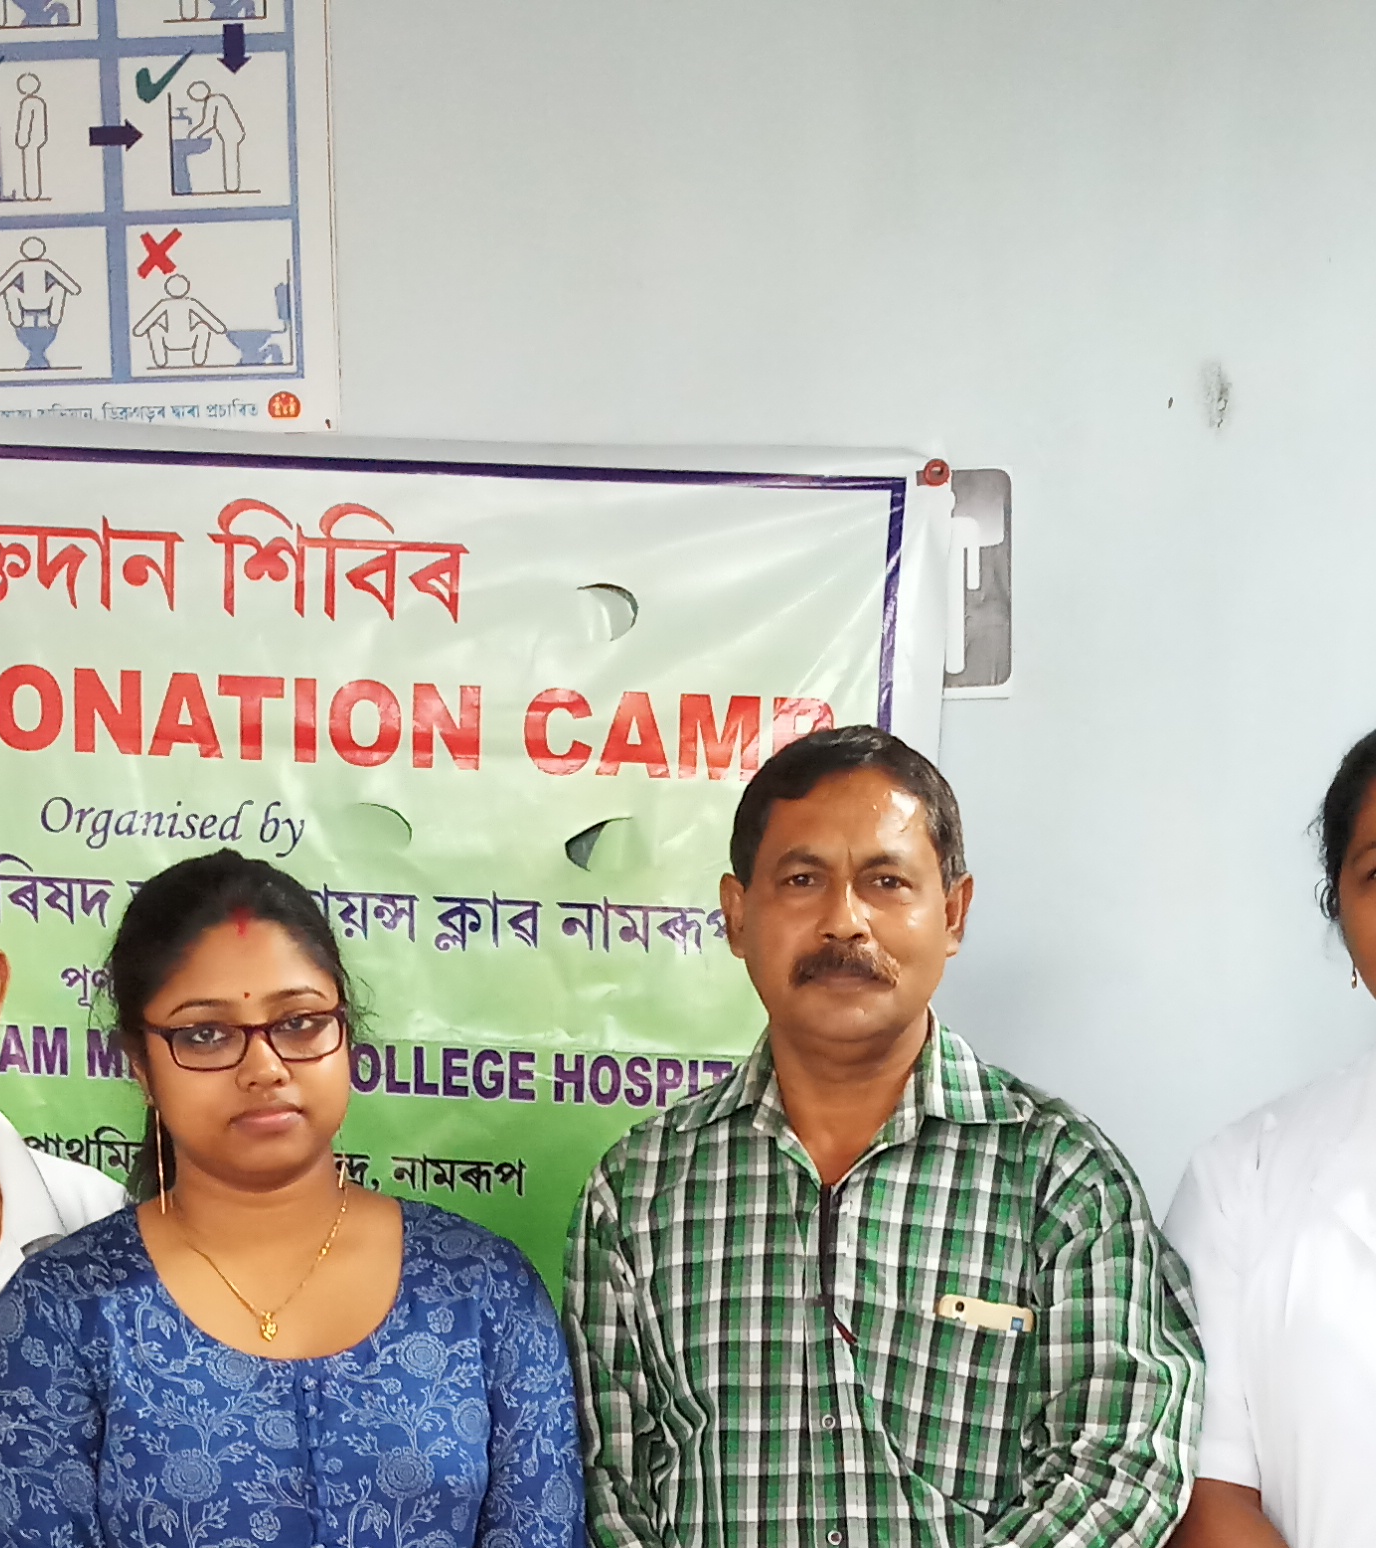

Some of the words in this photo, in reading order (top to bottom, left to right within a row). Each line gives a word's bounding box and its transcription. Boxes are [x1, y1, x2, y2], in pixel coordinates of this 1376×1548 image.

[207, 497, 470, 624] শিবিৰ
[40, 796, 255, 850] Organised
[259, 801, 306, 858] by
[350, 1042, 536, 1101] OLLEGE
[554, 1052, 734, 1108] HOSPIT
